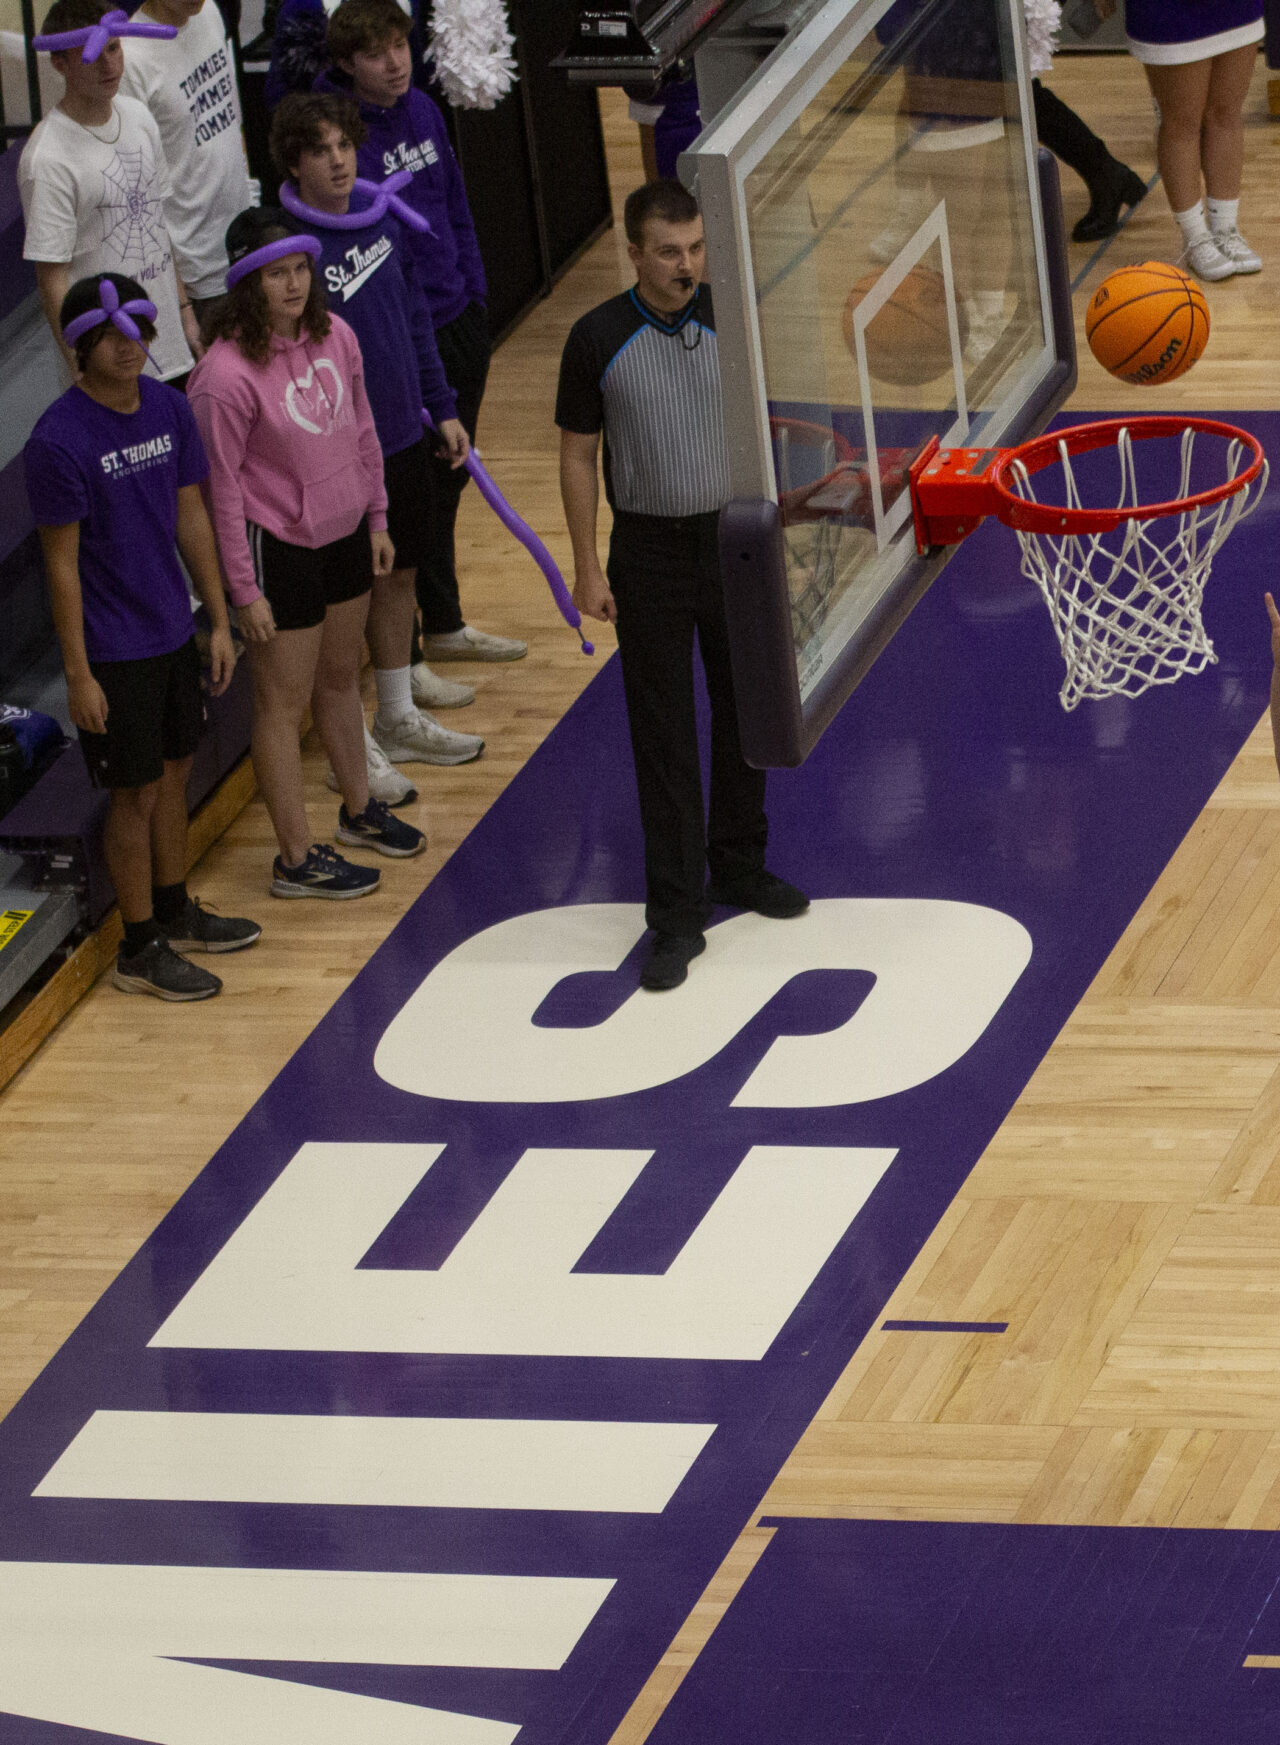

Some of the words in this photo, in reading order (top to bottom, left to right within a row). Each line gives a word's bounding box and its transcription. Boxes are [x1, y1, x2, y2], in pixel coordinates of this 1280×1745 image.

[324, 264, 353, 292] St.
[344, 234, 392, 275] Thomas
[101, 451, 123, 473] ST.
[121, 434, 173, 464] THOMAS
[112, 455, 169, 480] ENGNEERING
